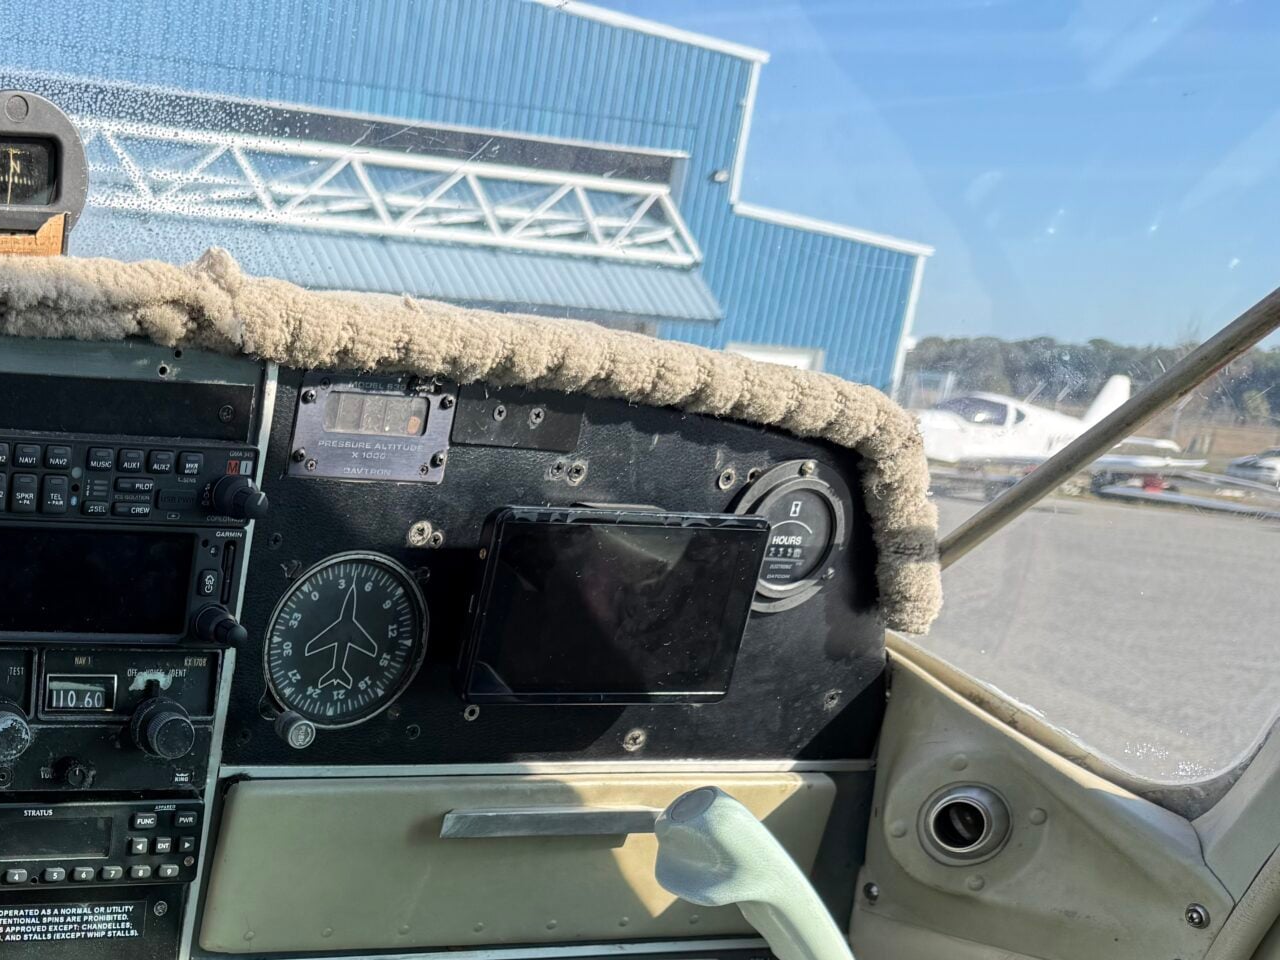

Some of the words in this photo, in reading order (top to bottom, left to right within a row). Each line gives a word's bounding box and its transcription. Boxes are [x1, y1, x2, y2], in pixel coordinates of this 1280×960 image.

[319, 440, 372, 449] PRESSURE
[374, 443, 424, 451] ALTITUDE
[772, 536, 802, 545] HOURS
[9, 667, 24, 675] TEST
[53, 690, 104, 708] 110.60
[23, 809, 53, 817] STRATUS
